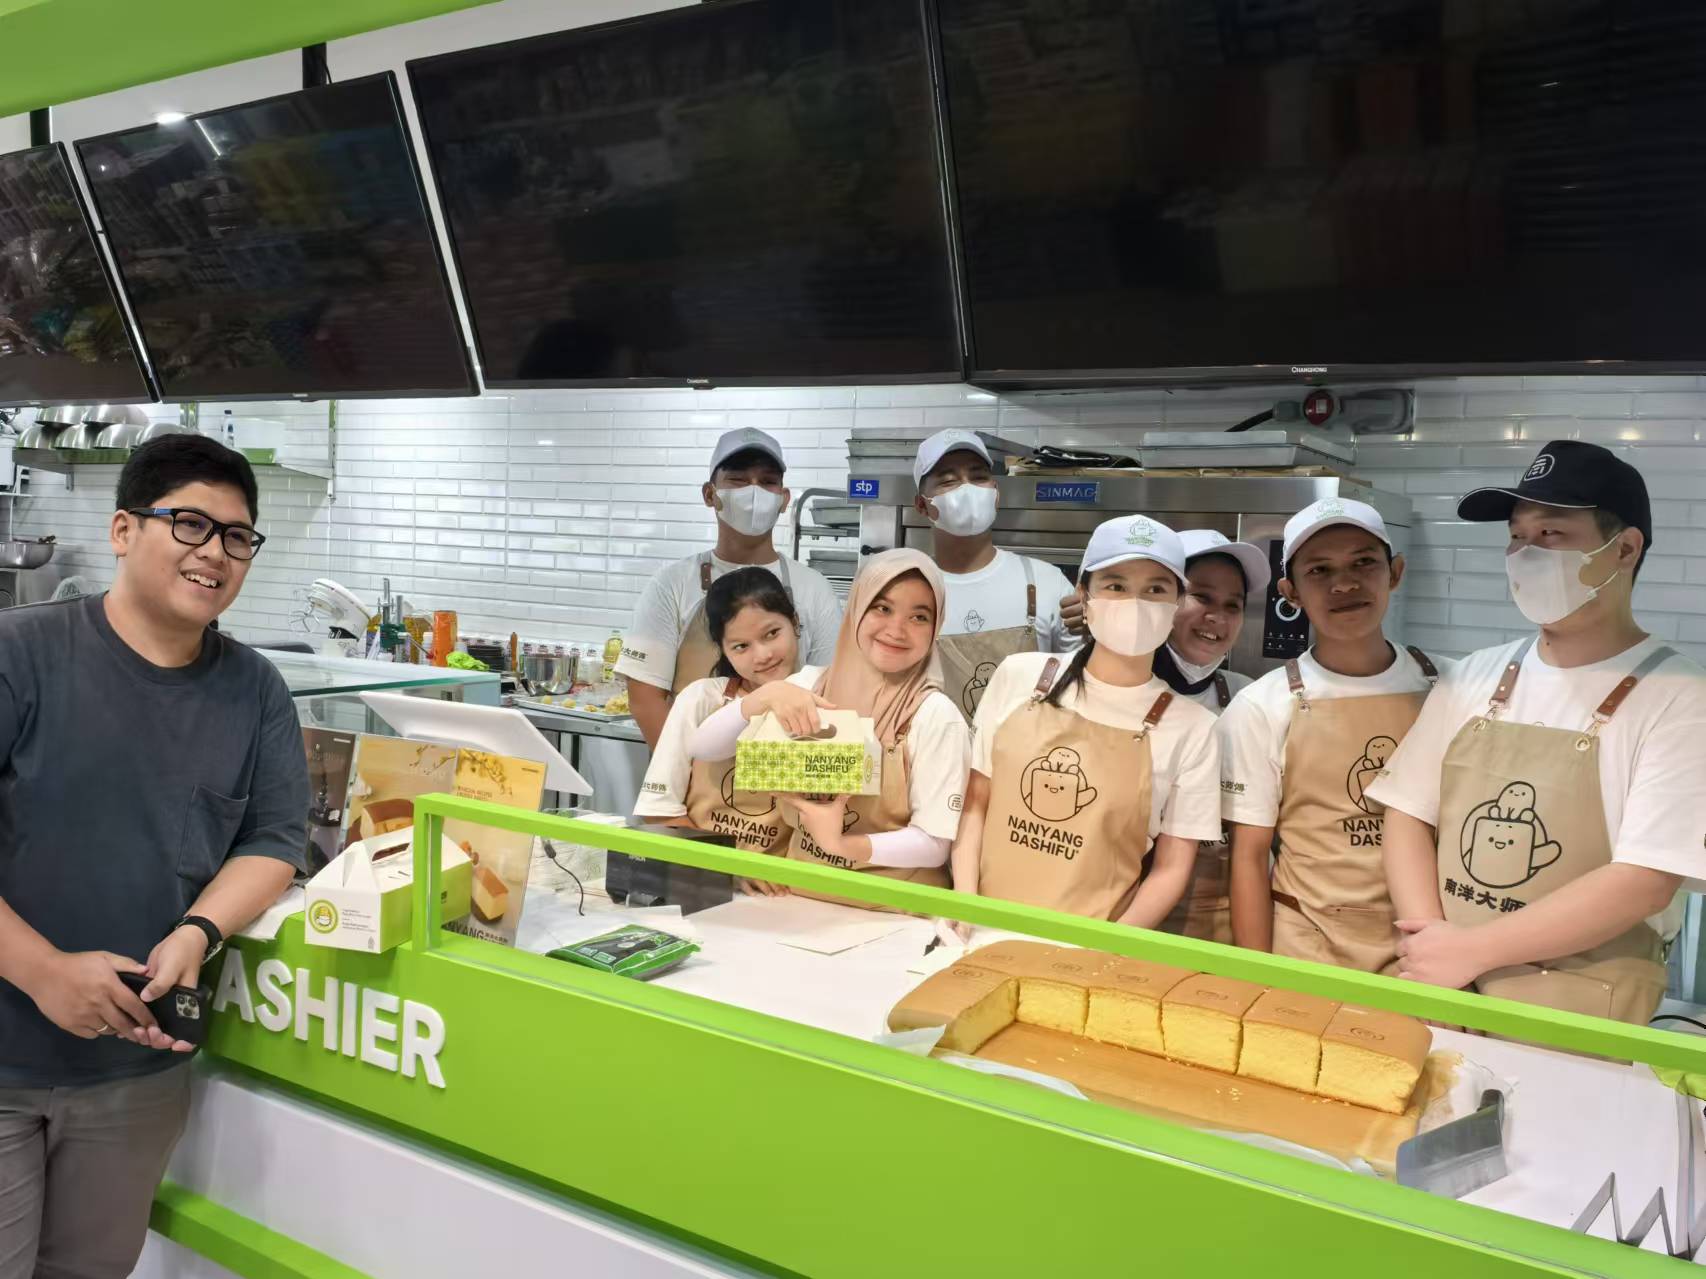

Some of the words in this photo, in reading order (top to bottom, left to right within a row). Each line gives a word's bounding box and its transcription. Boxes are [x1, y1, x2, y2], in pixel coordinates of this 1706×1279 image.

[855, 480, 873, 495] stp
[1038, 487, 1096, 498] SINMAG
[804, 755, 857, 765] NANYANG
[804, 764, 849, 773] DASHIFU
[711, 811, 778, 837] NANYANG
[1008, 814, 1084, 848] NANYANG
[800, 838, 853, 868] DASHIFU
[1010, 830, 1076, 860] DASHIFU
[212, 947, 446, 1089] ASHIER
